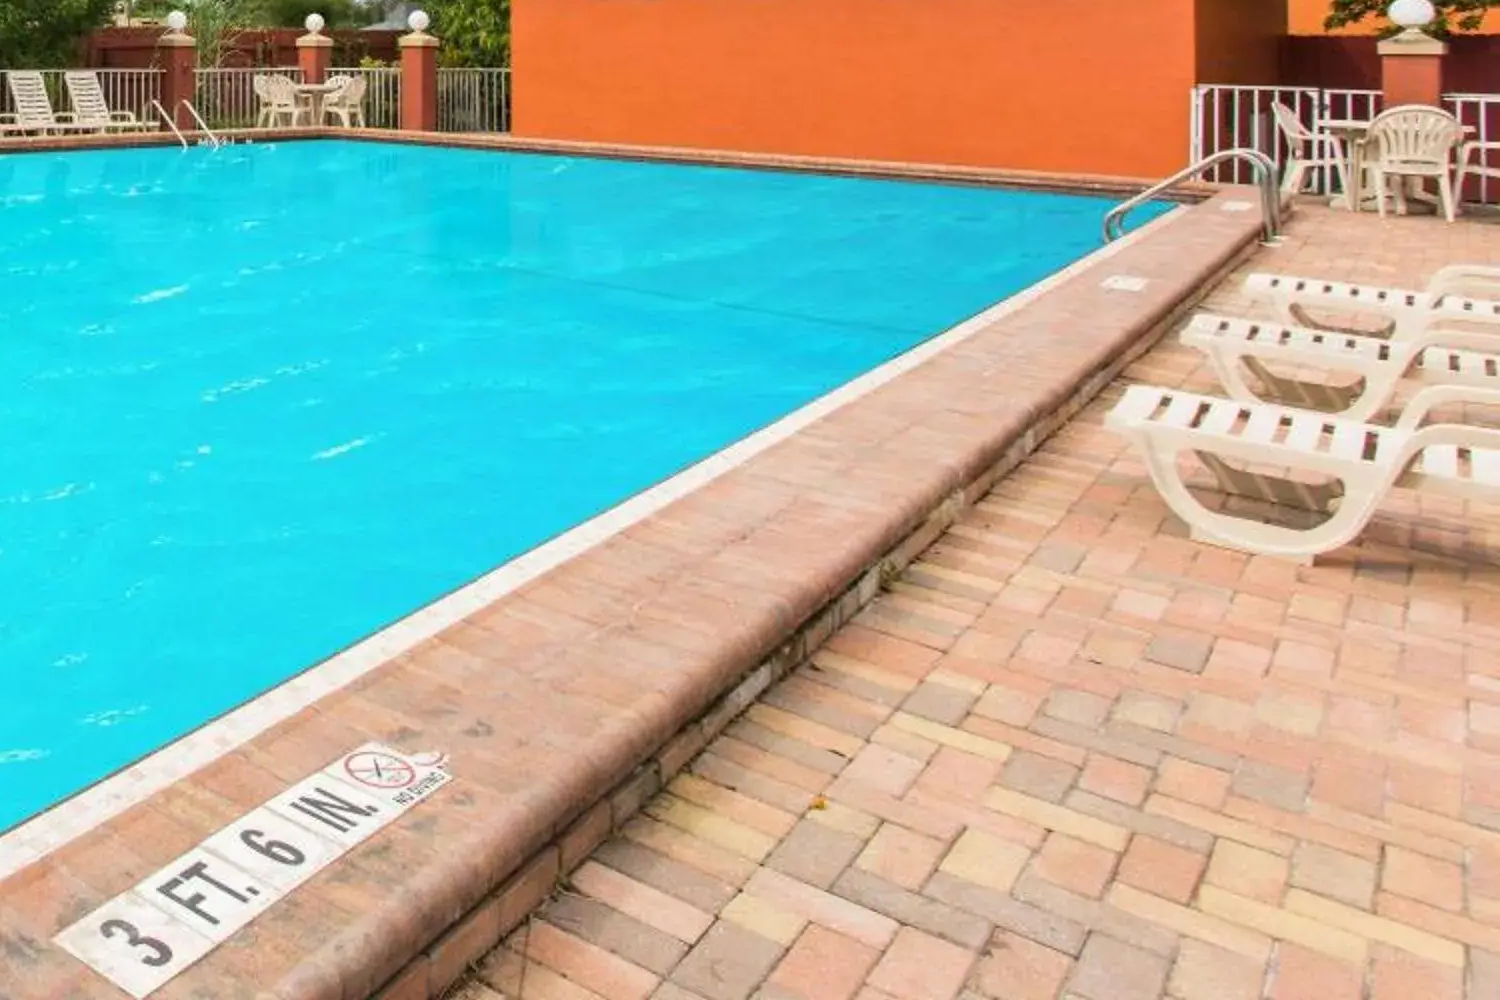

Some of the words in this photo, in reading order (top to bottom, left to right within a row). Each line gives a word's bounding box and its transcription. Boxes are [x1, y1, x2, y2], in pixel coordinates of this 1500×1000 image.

[100, 919, 173, 967] 3
[156, 862, 260, 925] FT.
[240, 829, 305, 866] 6
[290, 787, 379, 833] IN.
